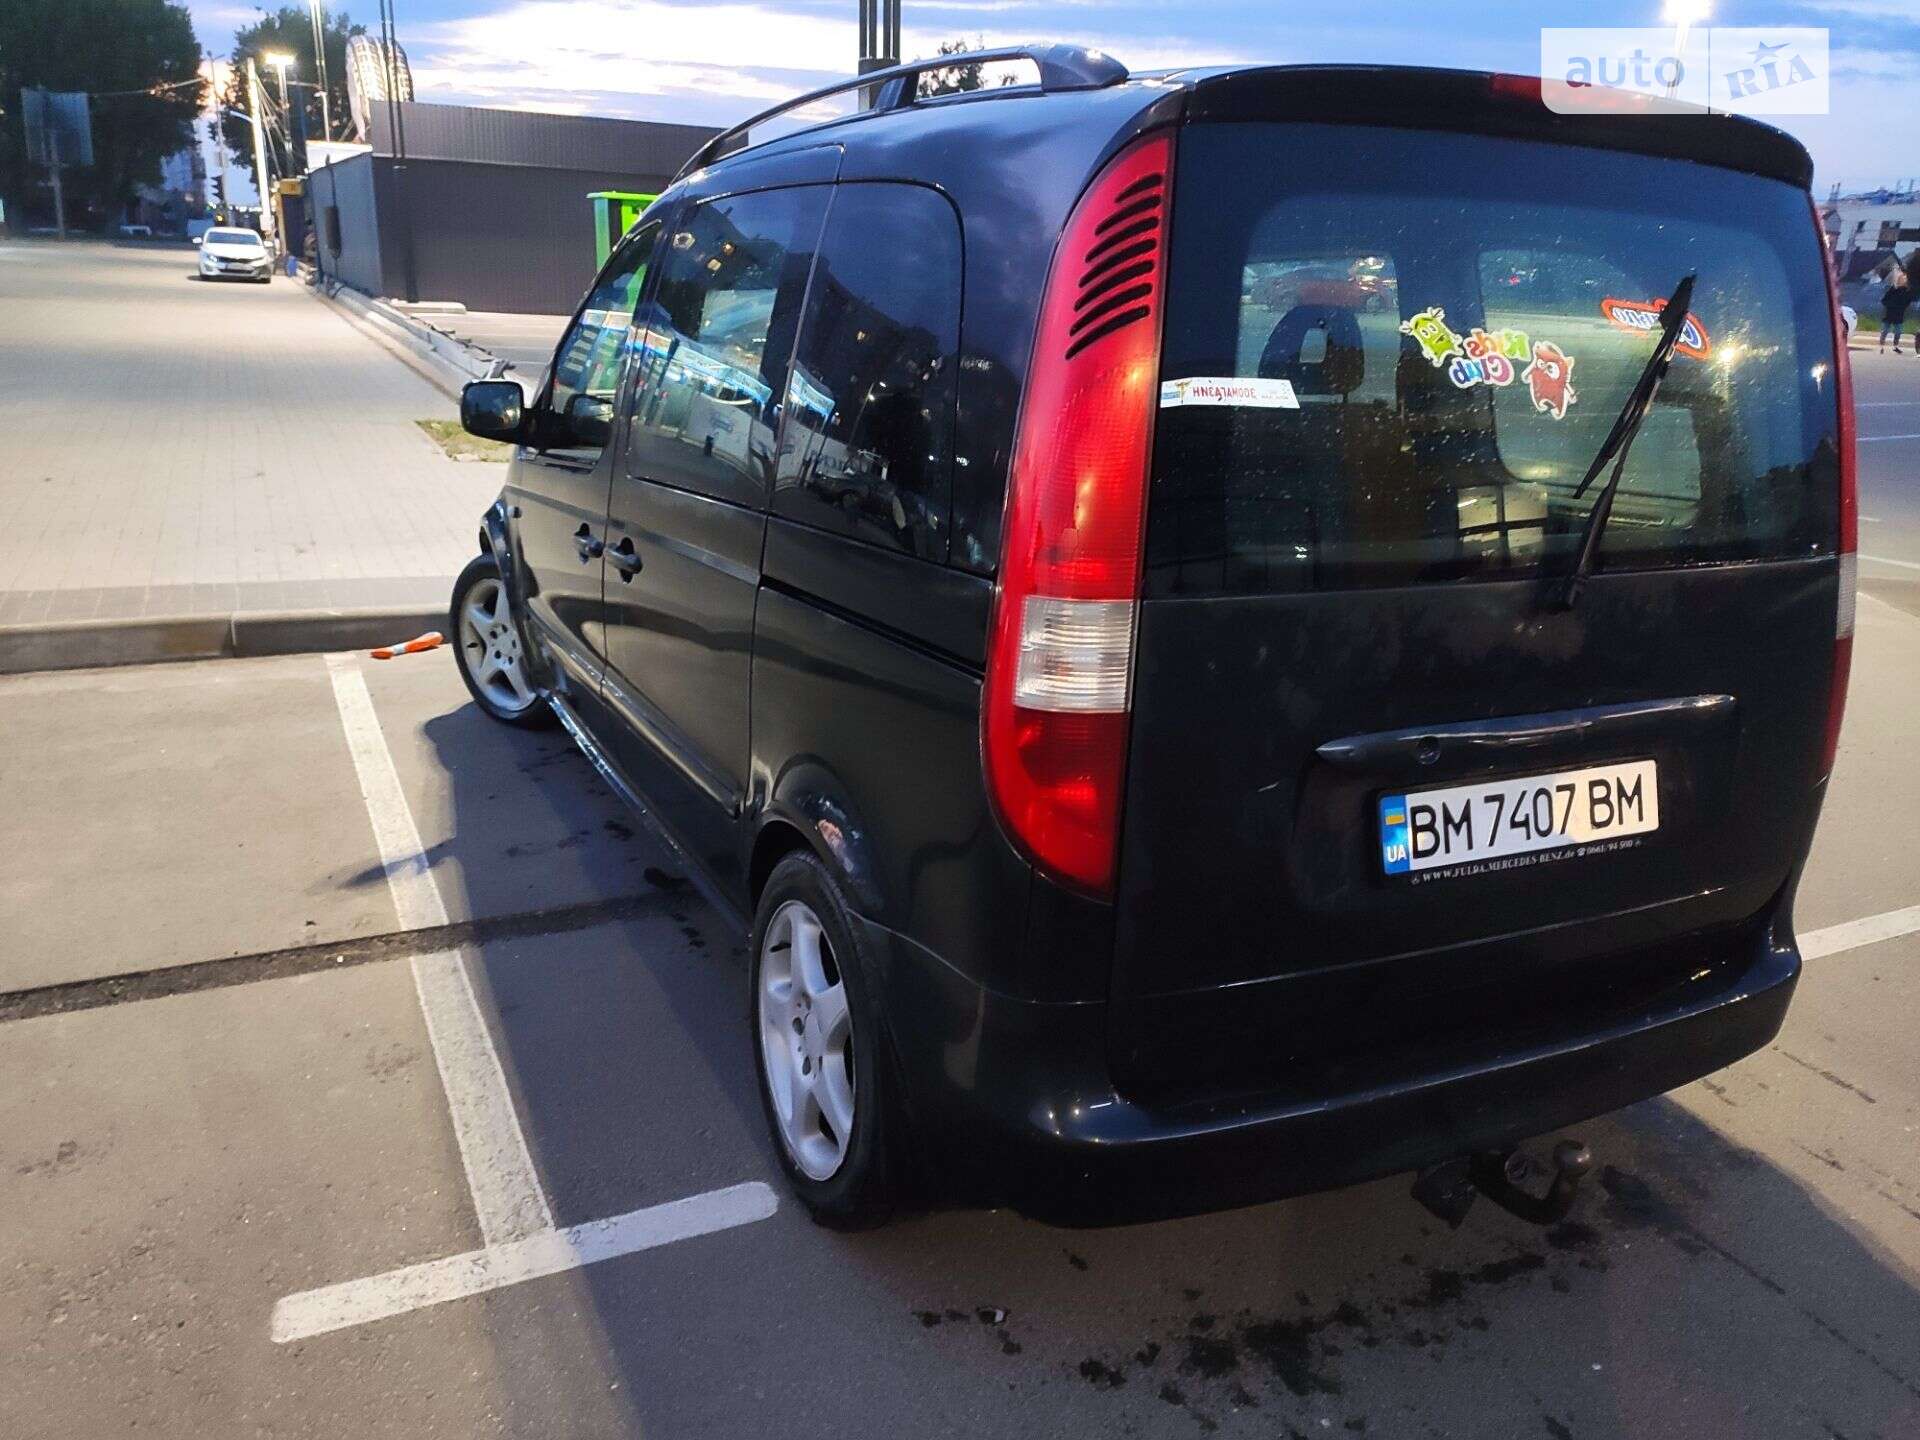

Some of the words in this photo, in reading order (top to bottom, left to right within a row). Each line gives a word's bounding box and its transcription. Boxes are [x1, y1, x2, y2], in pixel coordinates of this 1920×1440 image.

[1410, 798, 1474, 860] BM
[1484, 783, 1576, 847] 7407
[1588, 773, 1644, 830] BM
[1387, 845, 1408, 863] UA
